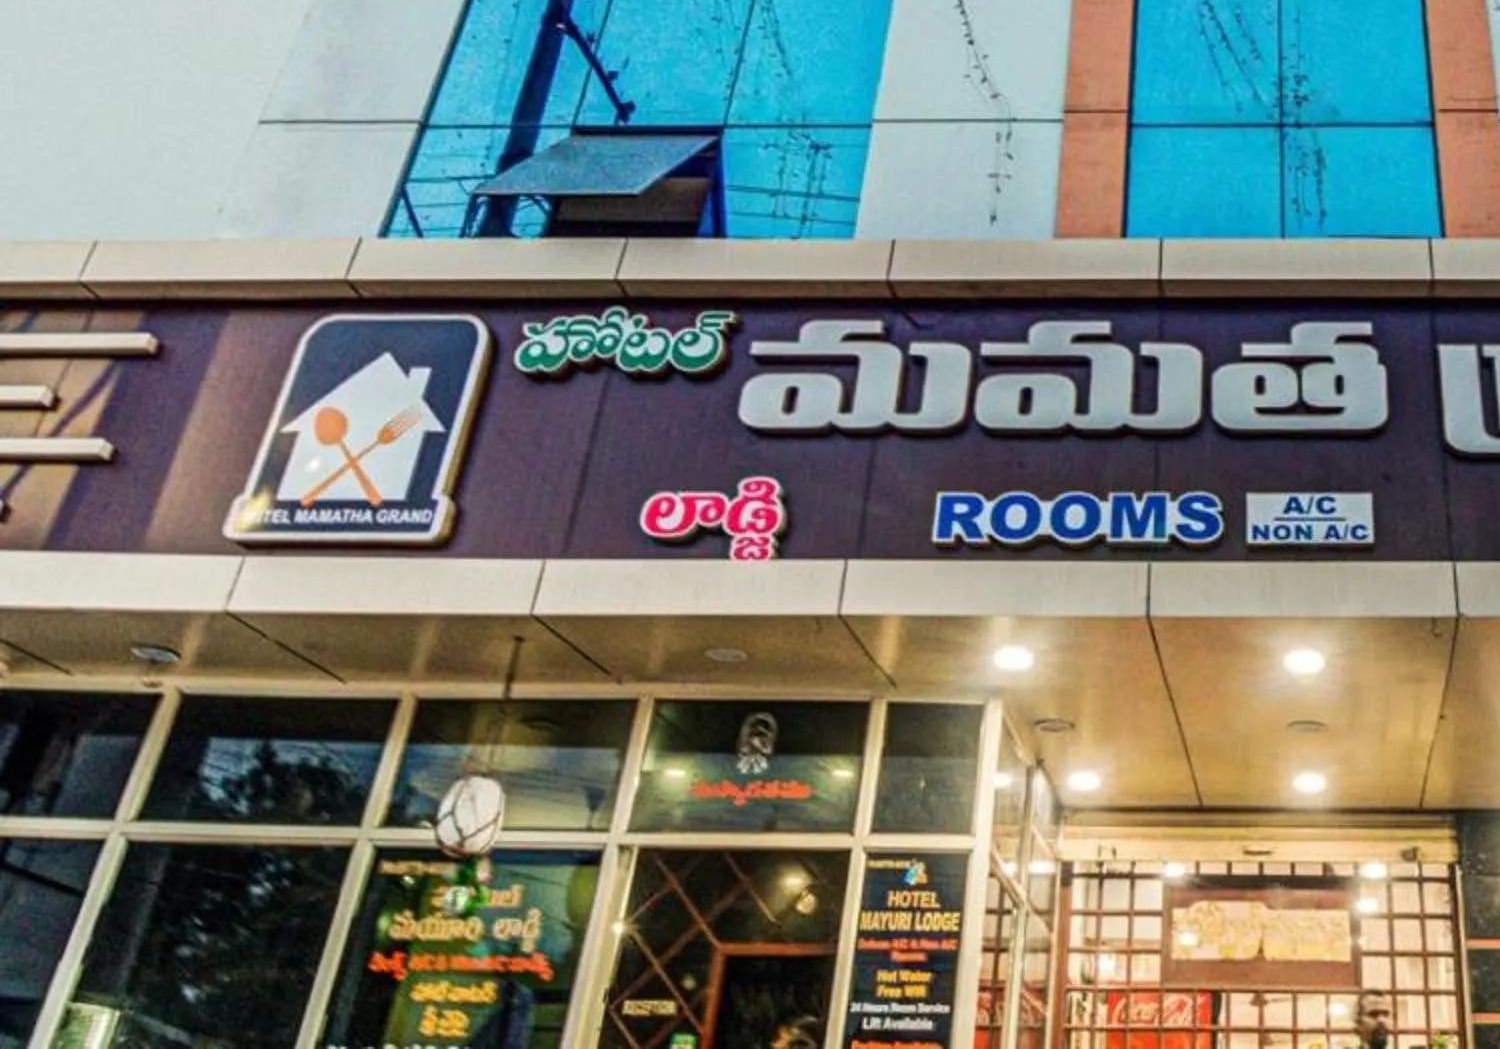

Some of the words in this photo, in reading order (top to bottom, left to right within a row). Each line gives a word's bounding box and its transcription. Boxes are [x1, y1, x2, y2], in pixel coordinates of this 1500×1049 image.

[513, 306, 735, 374] హోటల్
[738, 319, 1388, 432] మమత
[1283, 494, 1336, 516] A/C
[294, 508, 373, 524] MAMATHA
[375, 508, 433, 524] GRAND
[641, 476, 783, 560] లాడ్జి
[932, 491, 1224, 544] ROOMS
[1250, 522, 1316, 542] NON
[1324, 522, 1369, 541] A/C
[887, 890, 941, 908] HOTEL
[859, 911, 913, 931] MAYURI
[915, 912, 961, 931] LODGE
